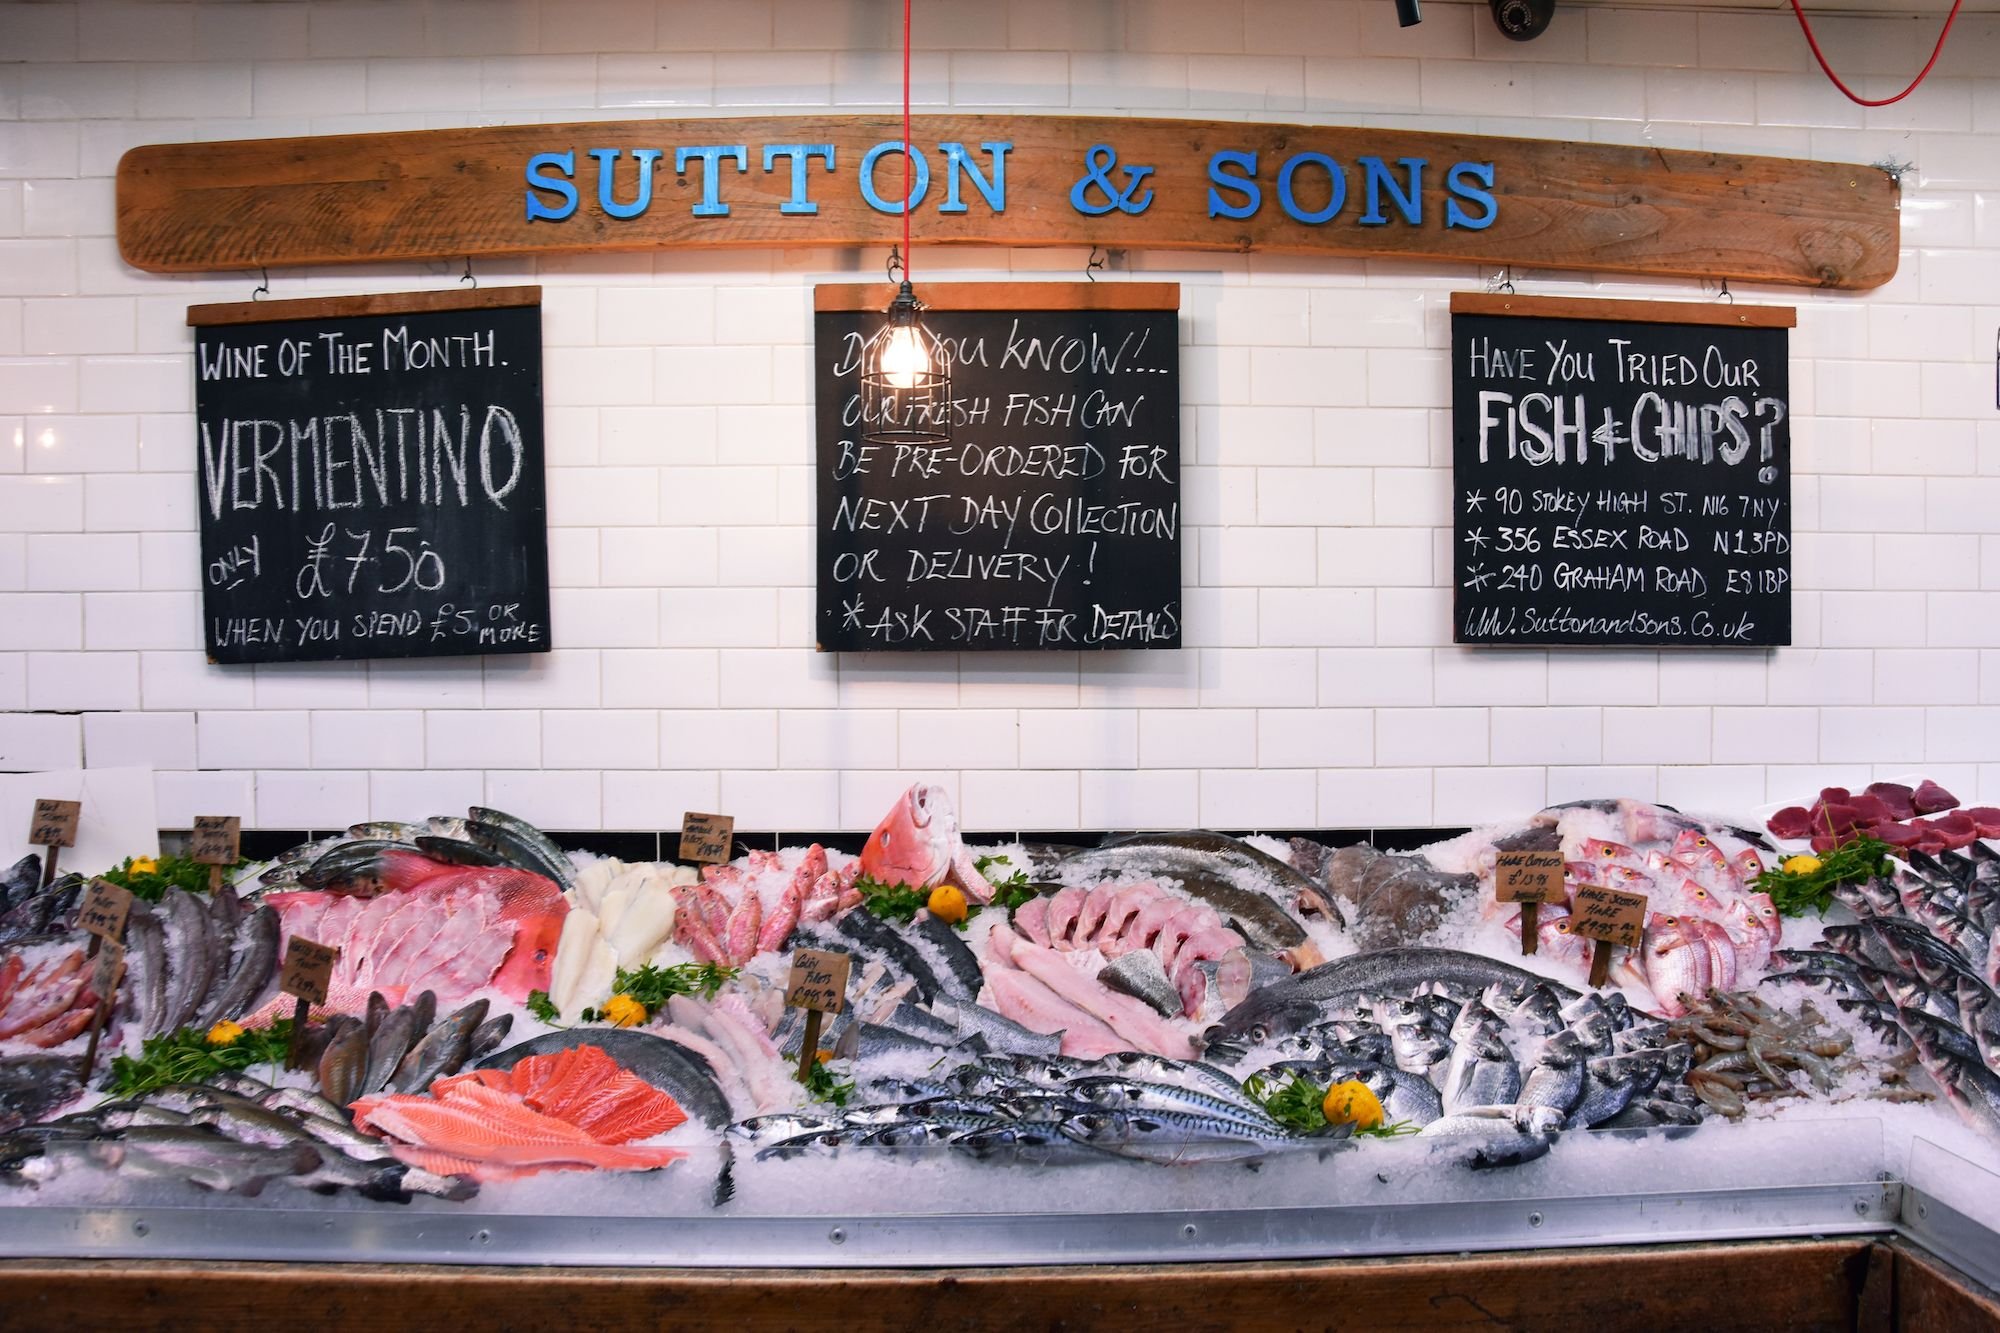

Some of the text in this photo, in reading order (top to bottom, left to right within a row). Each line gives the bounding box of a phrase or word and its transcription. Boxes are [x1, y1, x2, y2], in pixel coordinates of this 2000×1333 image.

[526, 139, 1499, 231] SUTTON & SONS
[200, 326, 509, 380] WINE OF THE MONTH.
[1469, 336, 1761, 389] HAVE YOU TRIED OUR
[842, 389, 1145, 429] OUR FRESH FISH CAN
[1479, 390, 1588, 467] FISH
[1631, 391, 1787, 485] CHIPS?
[200, 403, 524, 521] VERMENTINO
[833, 440, 1176, 484] BE PRE-ORDERED FOR
[833, 494, 951, 534] NEXT
[949, 495, 1022, 549] DAY
[1495, 487, 1523, 515] 90
[1532, 486, 1590, 528] STOKEY
[1596, 490, 1647, 514] HIGH
[1660, 492, 1693, 514] ST.
[1703, 495, 1729, 516] N16
[209, 534, 261, 586] ONLY
[1495, 529, 1541, 553] 356
[1553, 526, 1628, 551] ESSEX
[1637, 528, 1689, 553] ROAD
[833, 549, 886, 583] OR
[1497, 564, 1543, 592] 240
[1554, 562, 1645, 593] GRAHAM
[1656, 567, 1707, 599] ROAD
[215, 617, 284, 647] WHEN
[297, 616, 340, 646] YOU
[352, 610, 422, 638] SPEND
[488, 603, 520, 621] OR
[479, 622, 543, 645] MORE
[944, 605, 1032, 643] STAFF
[1083, 601, 1178, 643] DETAILS
